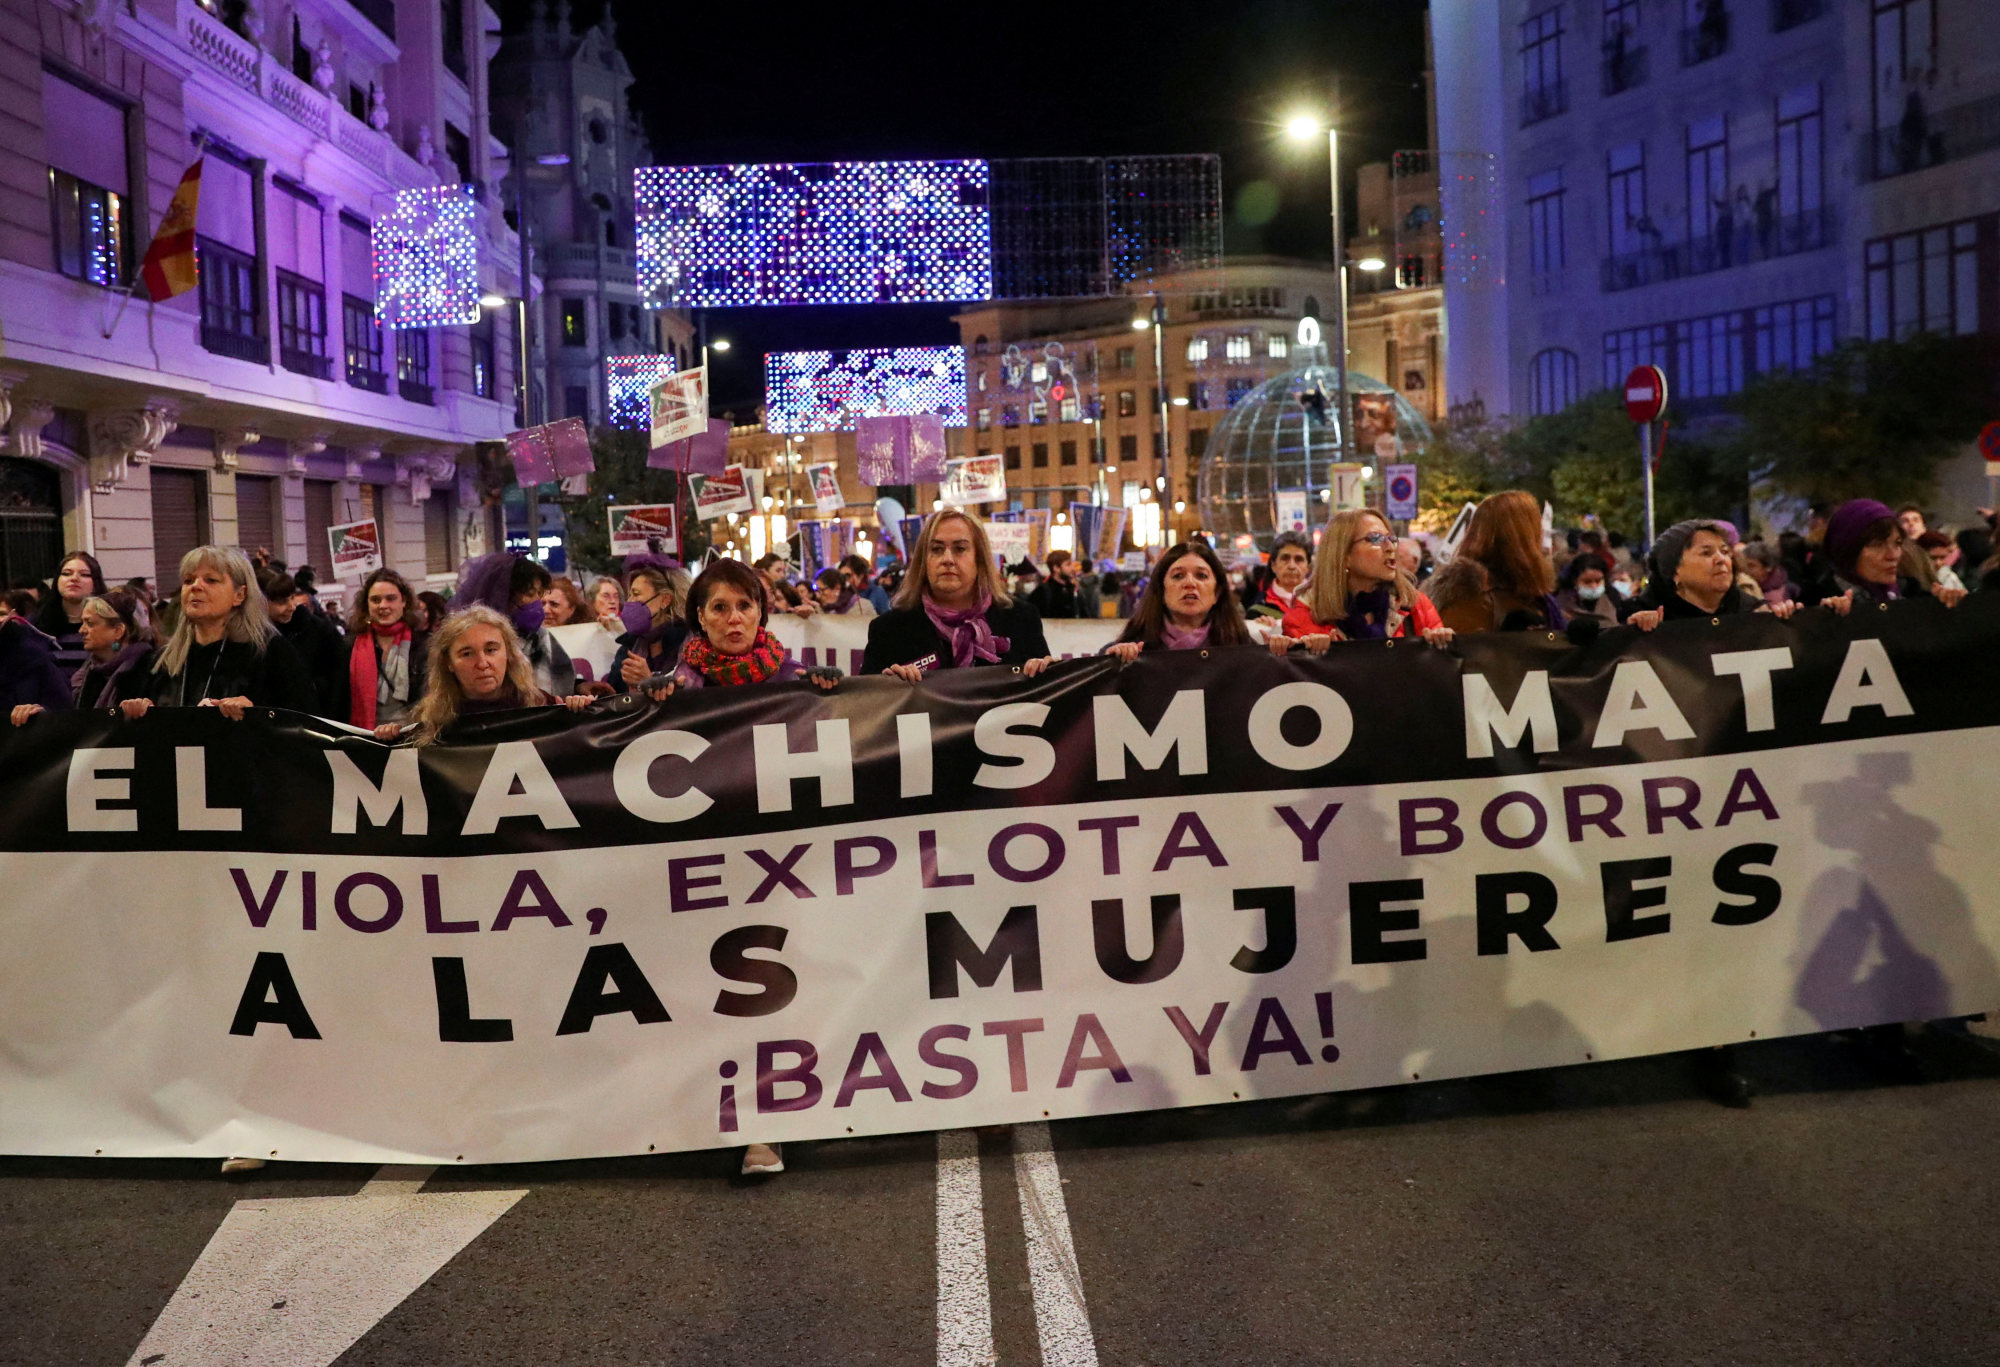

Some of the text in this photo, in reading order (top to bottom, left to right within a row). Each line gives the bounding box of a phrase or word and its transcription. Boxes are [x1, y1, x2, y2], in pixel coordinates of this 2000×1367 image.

[66, 638, 1914, 836] EL MACHISMO MATA
[229, 843, 1782, 1042] A LAS MUJERES
[230, 767, 1780, 935] VIOLA, EXPLOTA Y BORRA
[720, 993, 1340, 1132] ¡BASTA YA!
